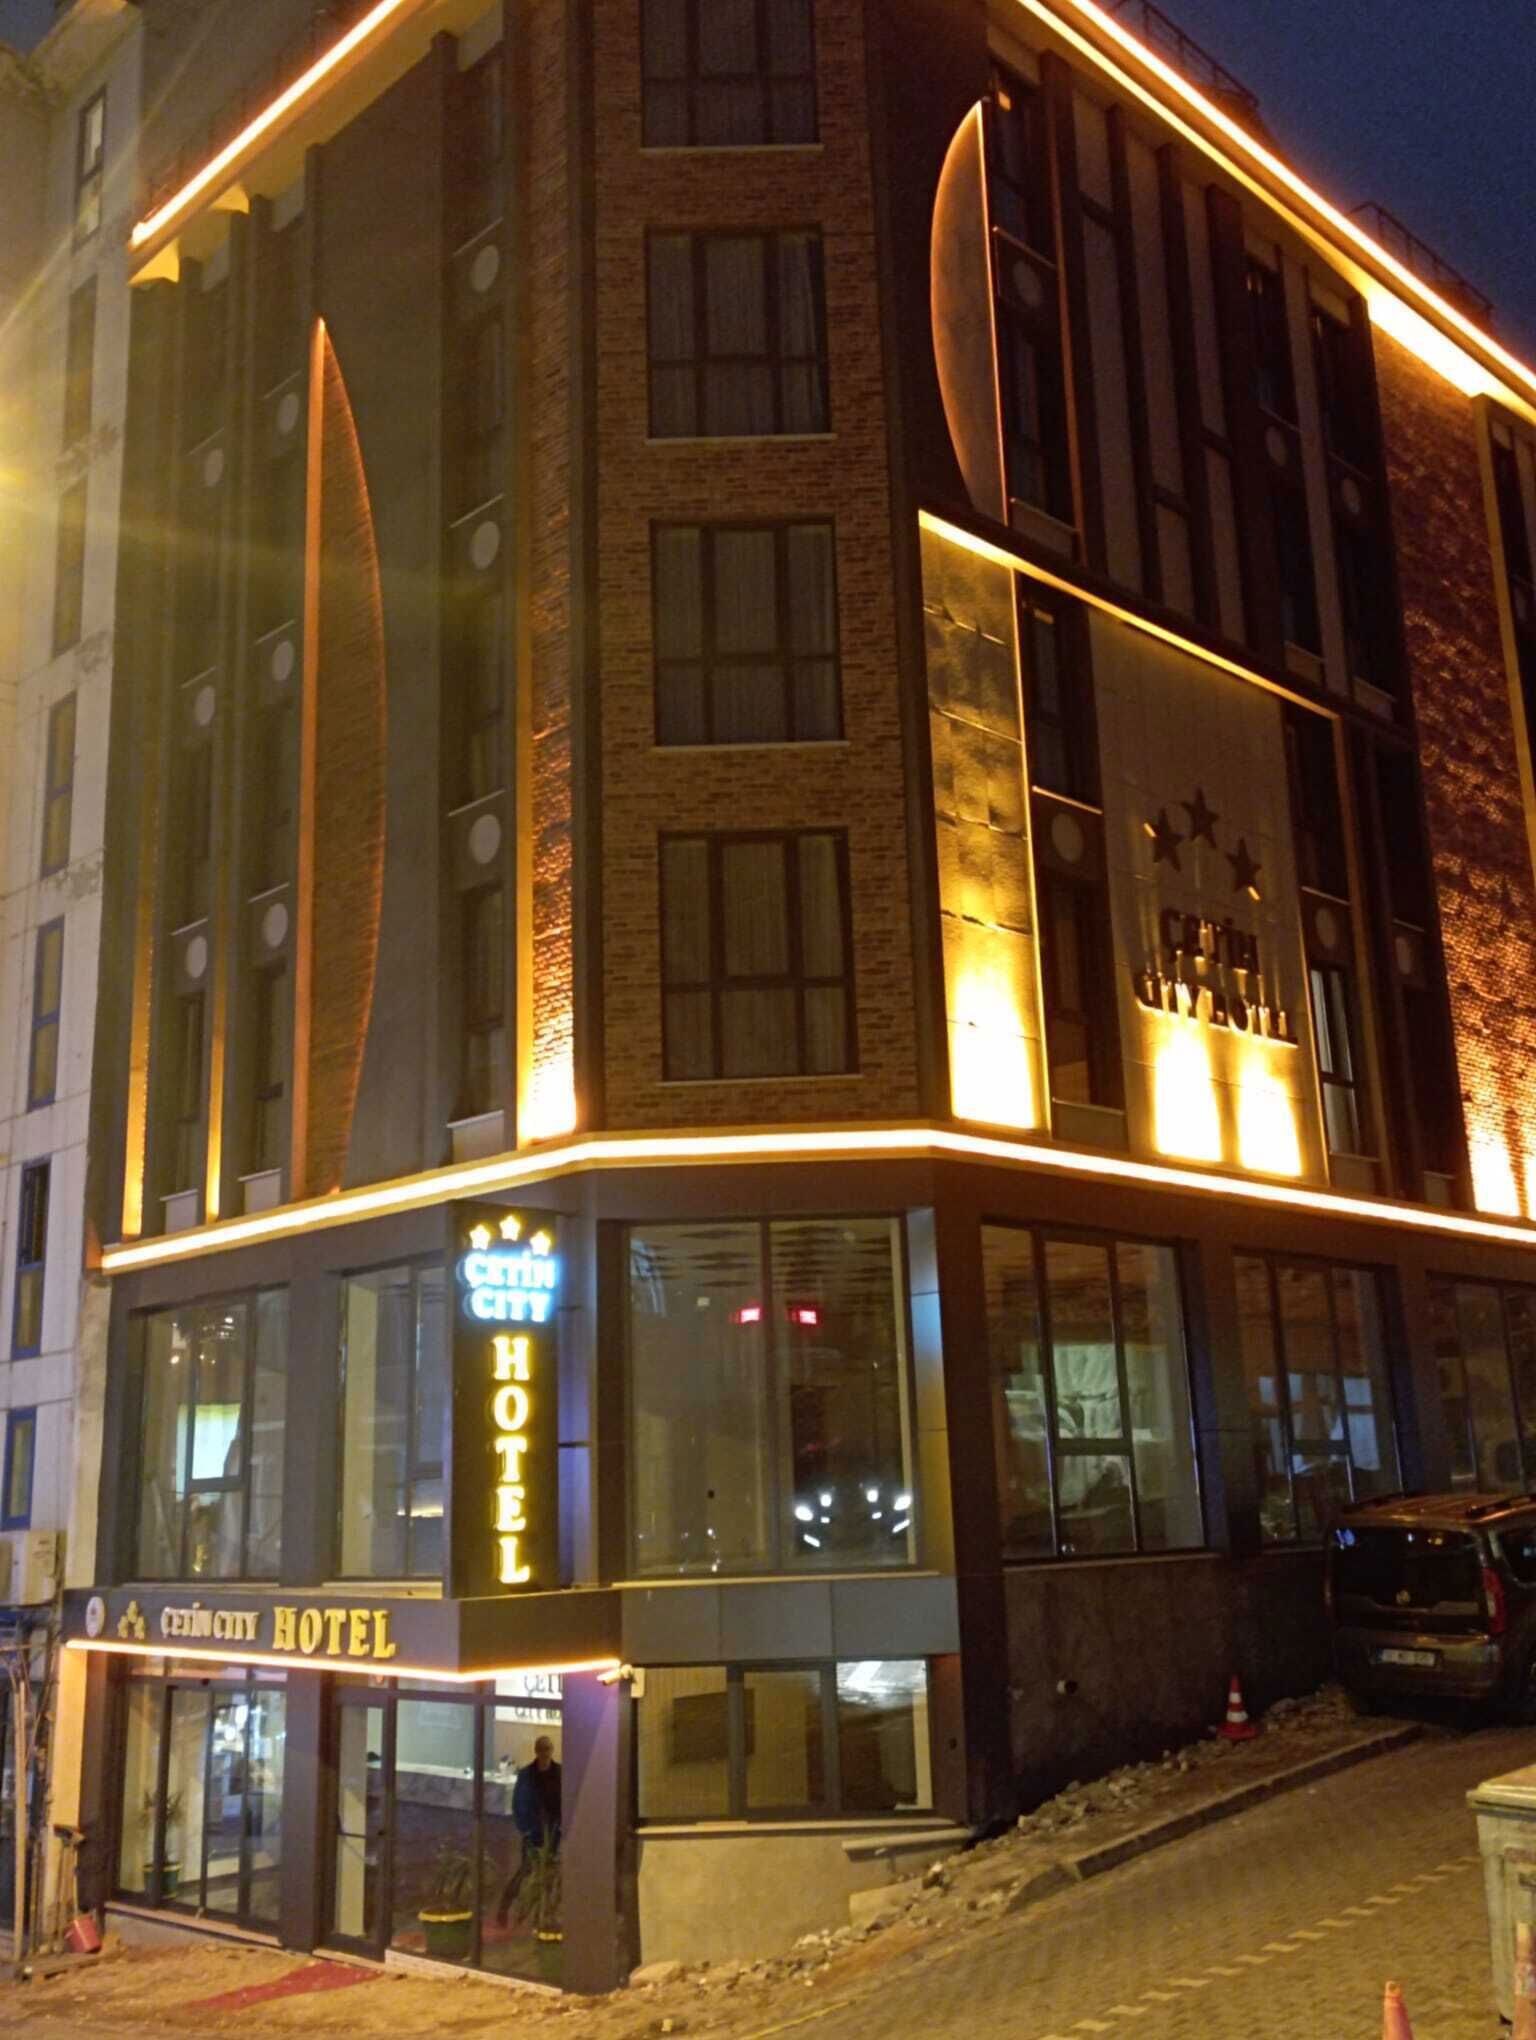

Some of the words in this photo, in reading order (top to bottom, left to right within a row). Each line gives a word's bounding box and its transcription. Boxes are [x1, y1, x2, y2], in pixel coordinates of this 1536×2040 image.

[471, 1290, 551, 1322] CITY
[492, 1335, 532, 1584] HOTEL
[213, 1609, 259, 1641] CITY
[272, 1605, 396, 1659] HOTEL
